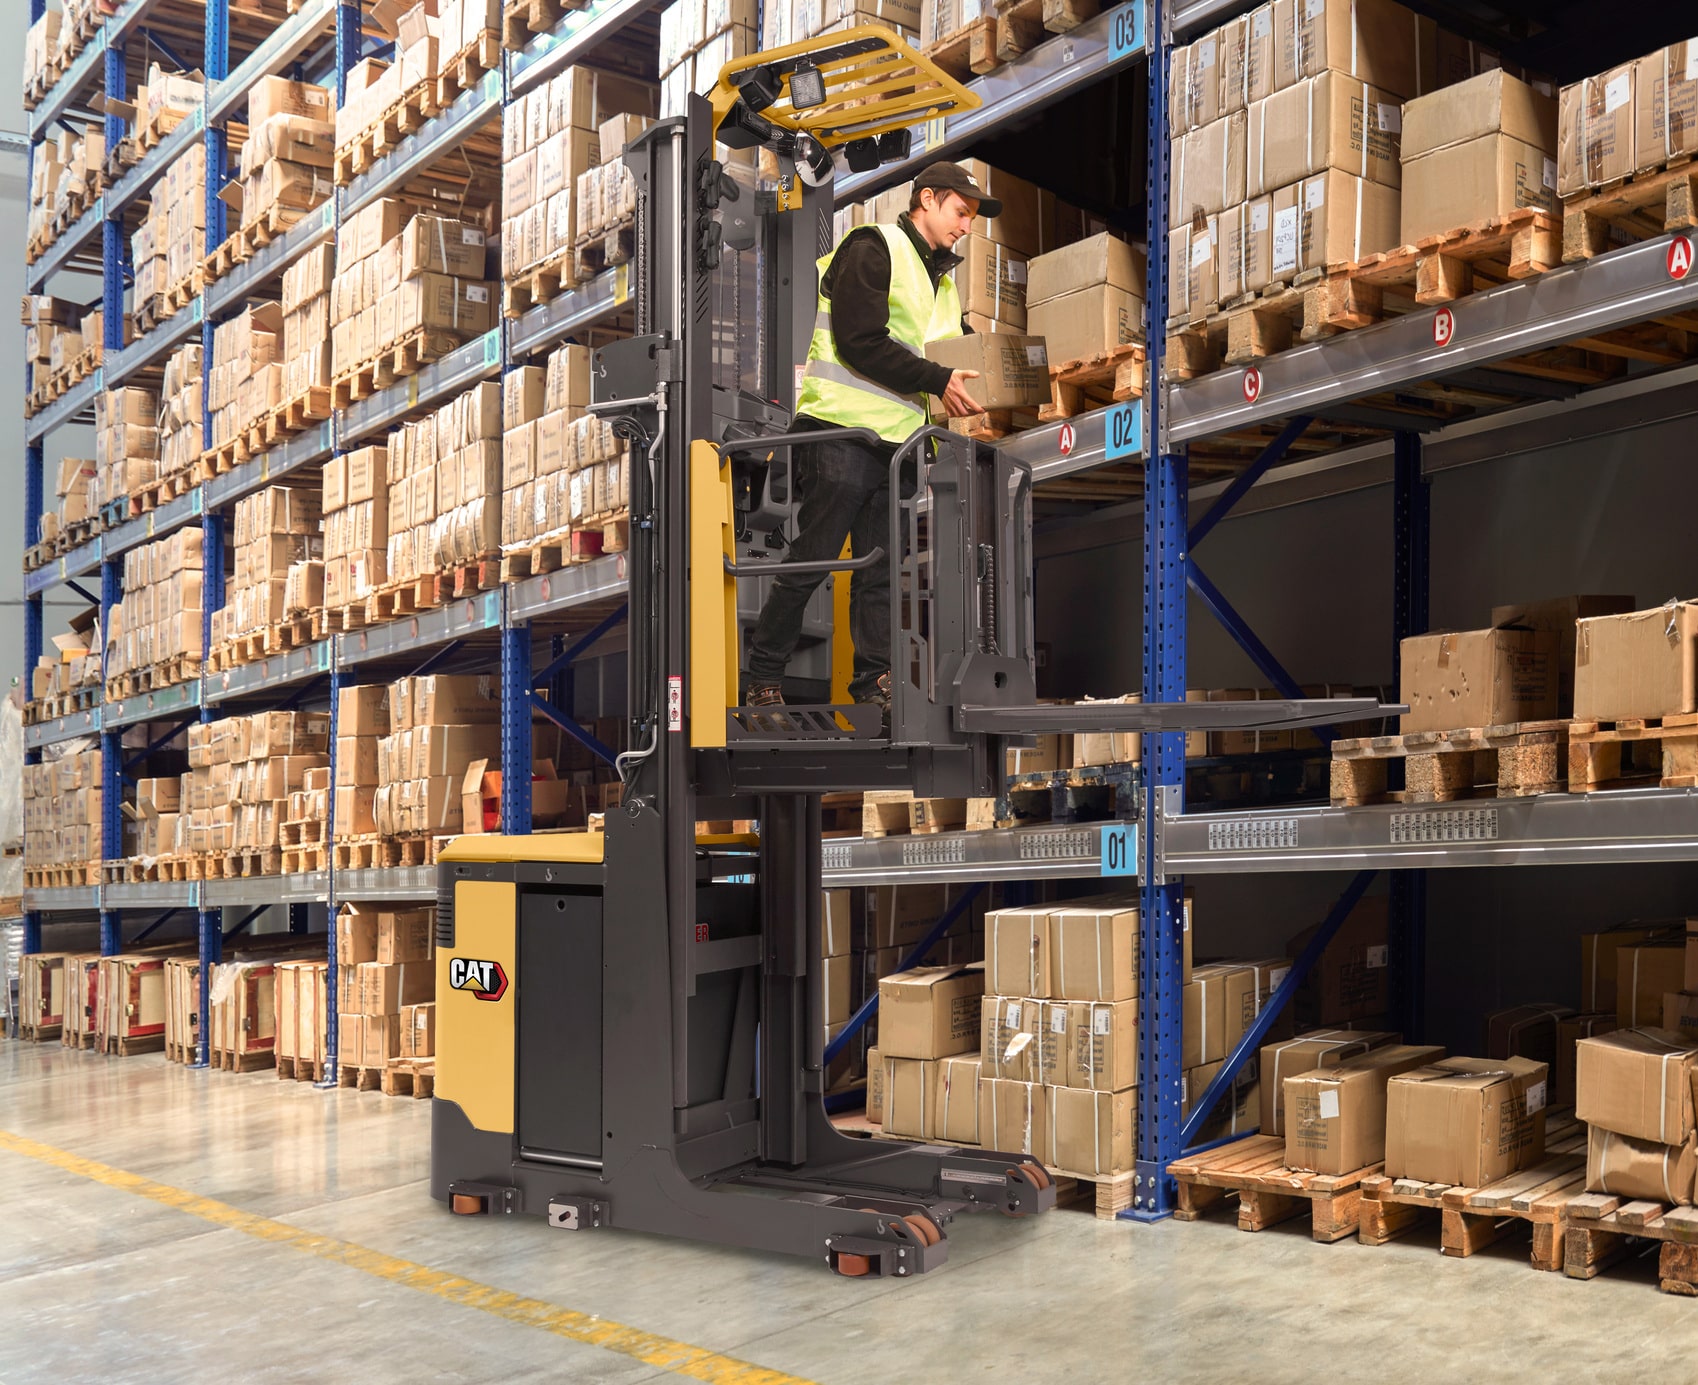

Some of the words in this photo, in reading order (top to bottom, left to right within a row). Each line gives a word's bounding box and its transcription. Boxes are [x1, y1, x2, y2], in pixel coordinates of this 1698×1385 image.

[1115, 9, 1135, 51] 03
[1671, 242, 1689, 273] A
[1435, 313, 1449, 342] B
[1244, 372, 1256, 397] C
[1060, 427, 1071, 450] A
[1112, 408, 1133, 449] 02
[1108, 831, 1126, 870] 01
[451, 959, 494, 992] CAT
